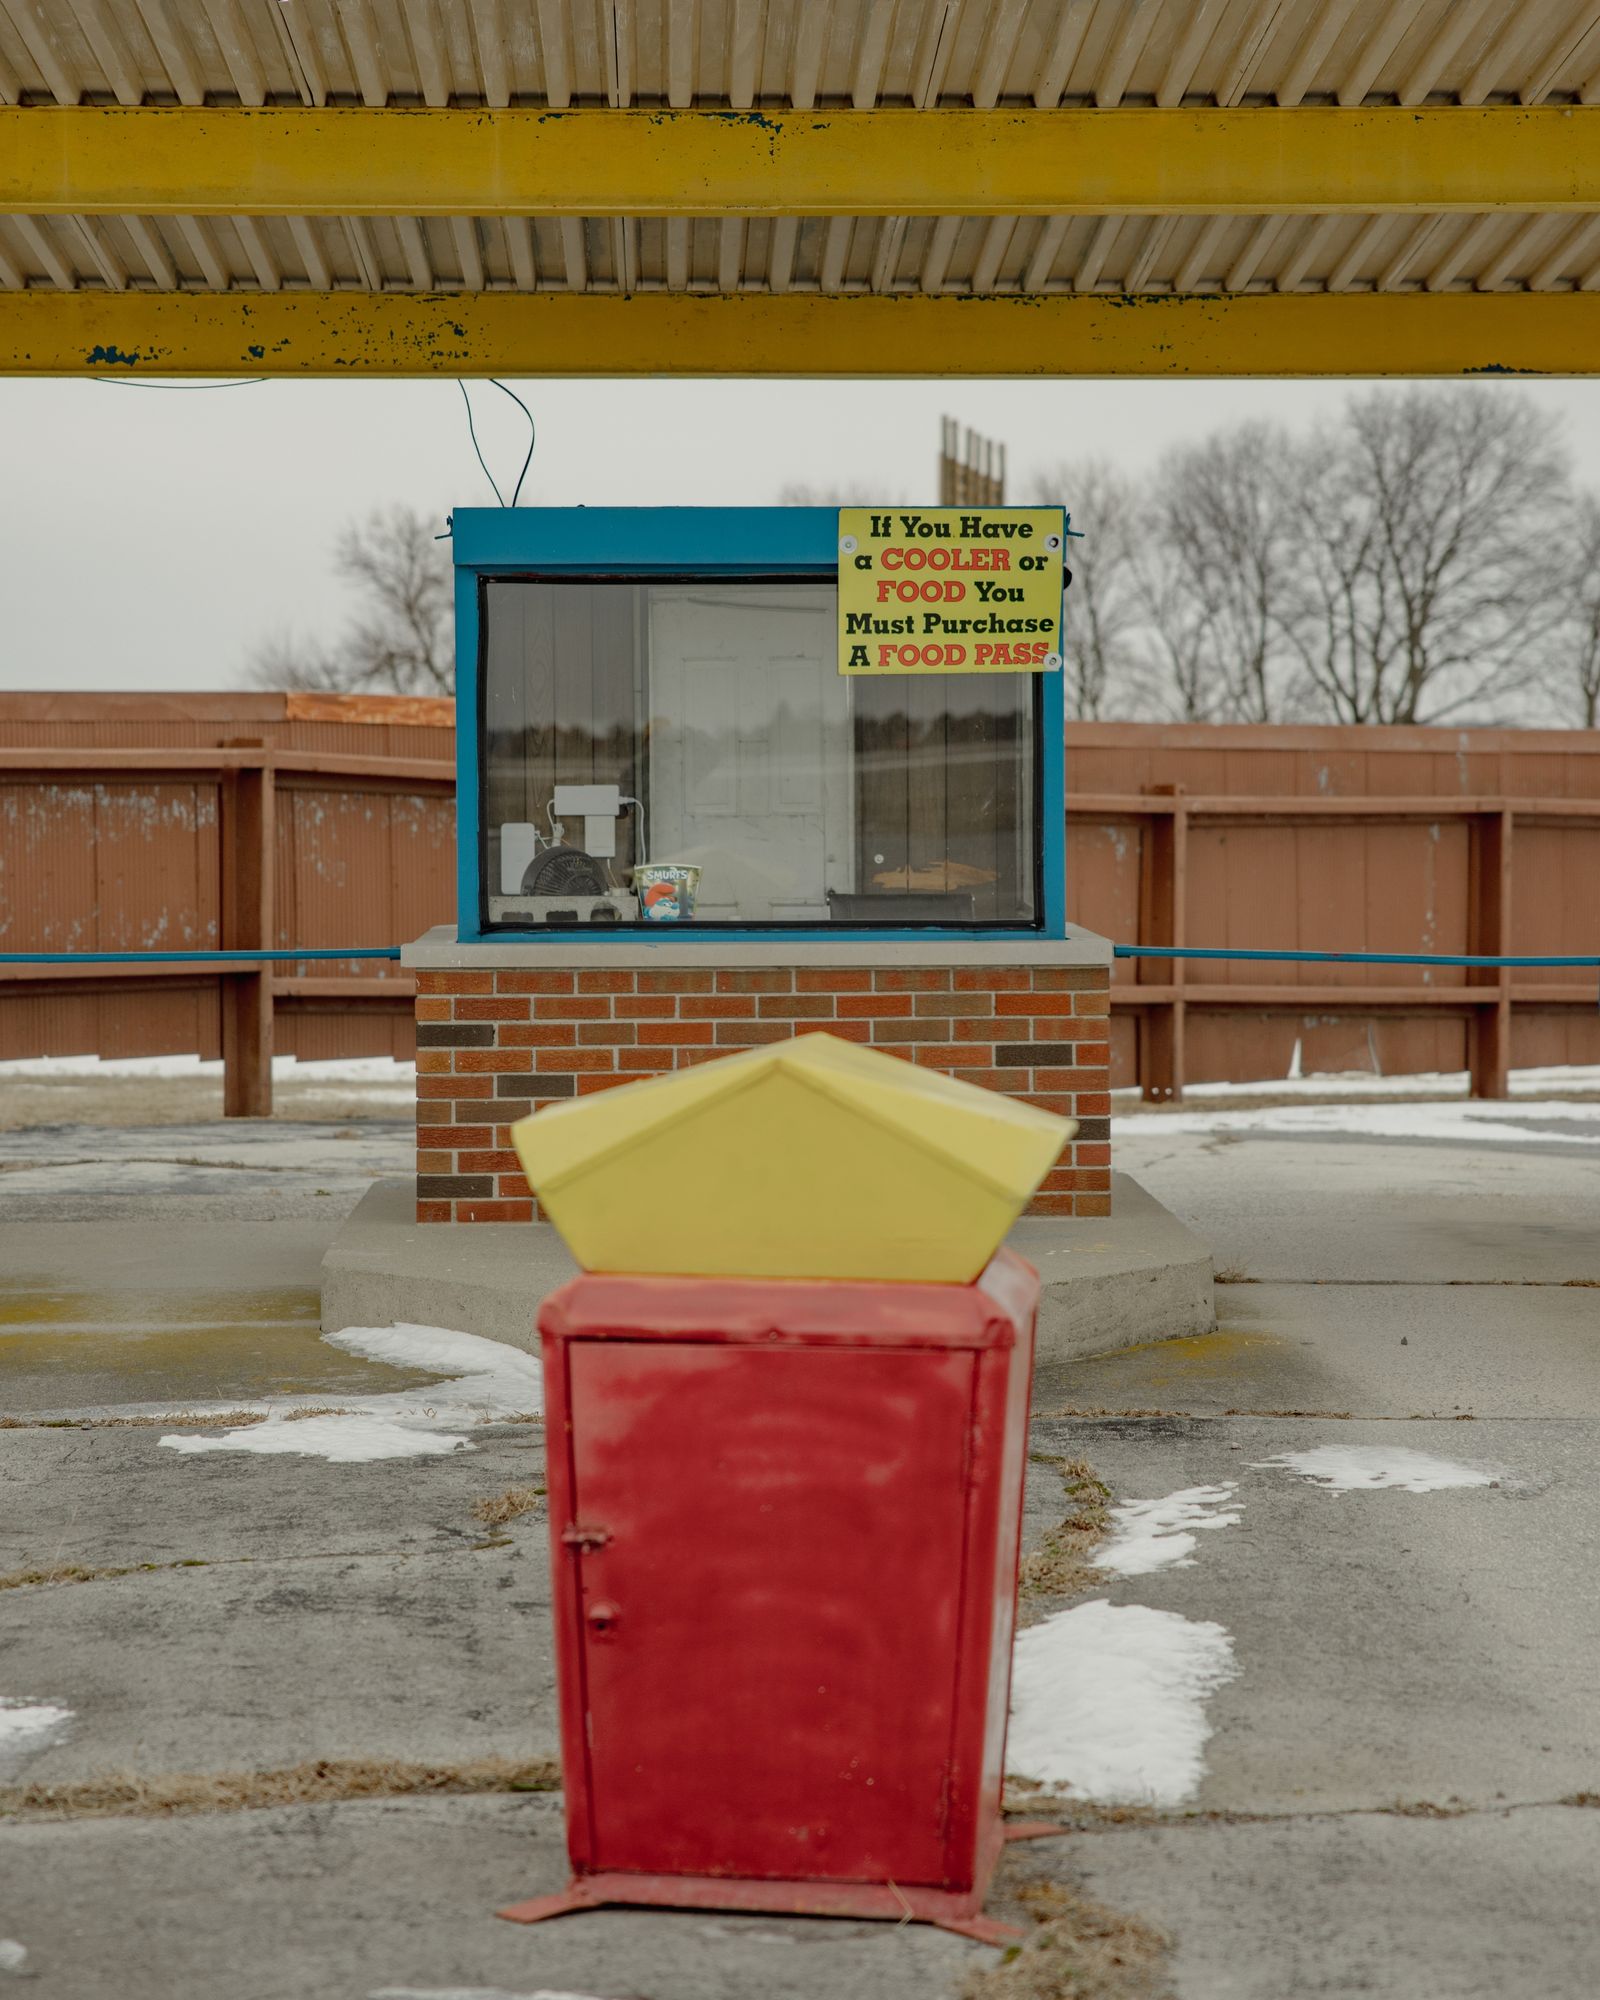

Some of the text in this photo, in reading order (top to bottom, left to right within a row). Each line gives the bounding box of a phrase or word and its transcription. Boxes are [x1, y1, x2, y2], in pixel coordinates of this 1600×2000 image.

[871, 516, 1033, 538] If You Have
[855, 548, 1048, 570] a COOLER or
[877, 581, 1024, 602] FOOD You
[846, 613, 1054, 634] Must Purchase
[849, 643, 1049, 666] A FOOD PASS
[647, 869, 688, 880] SMURFS
